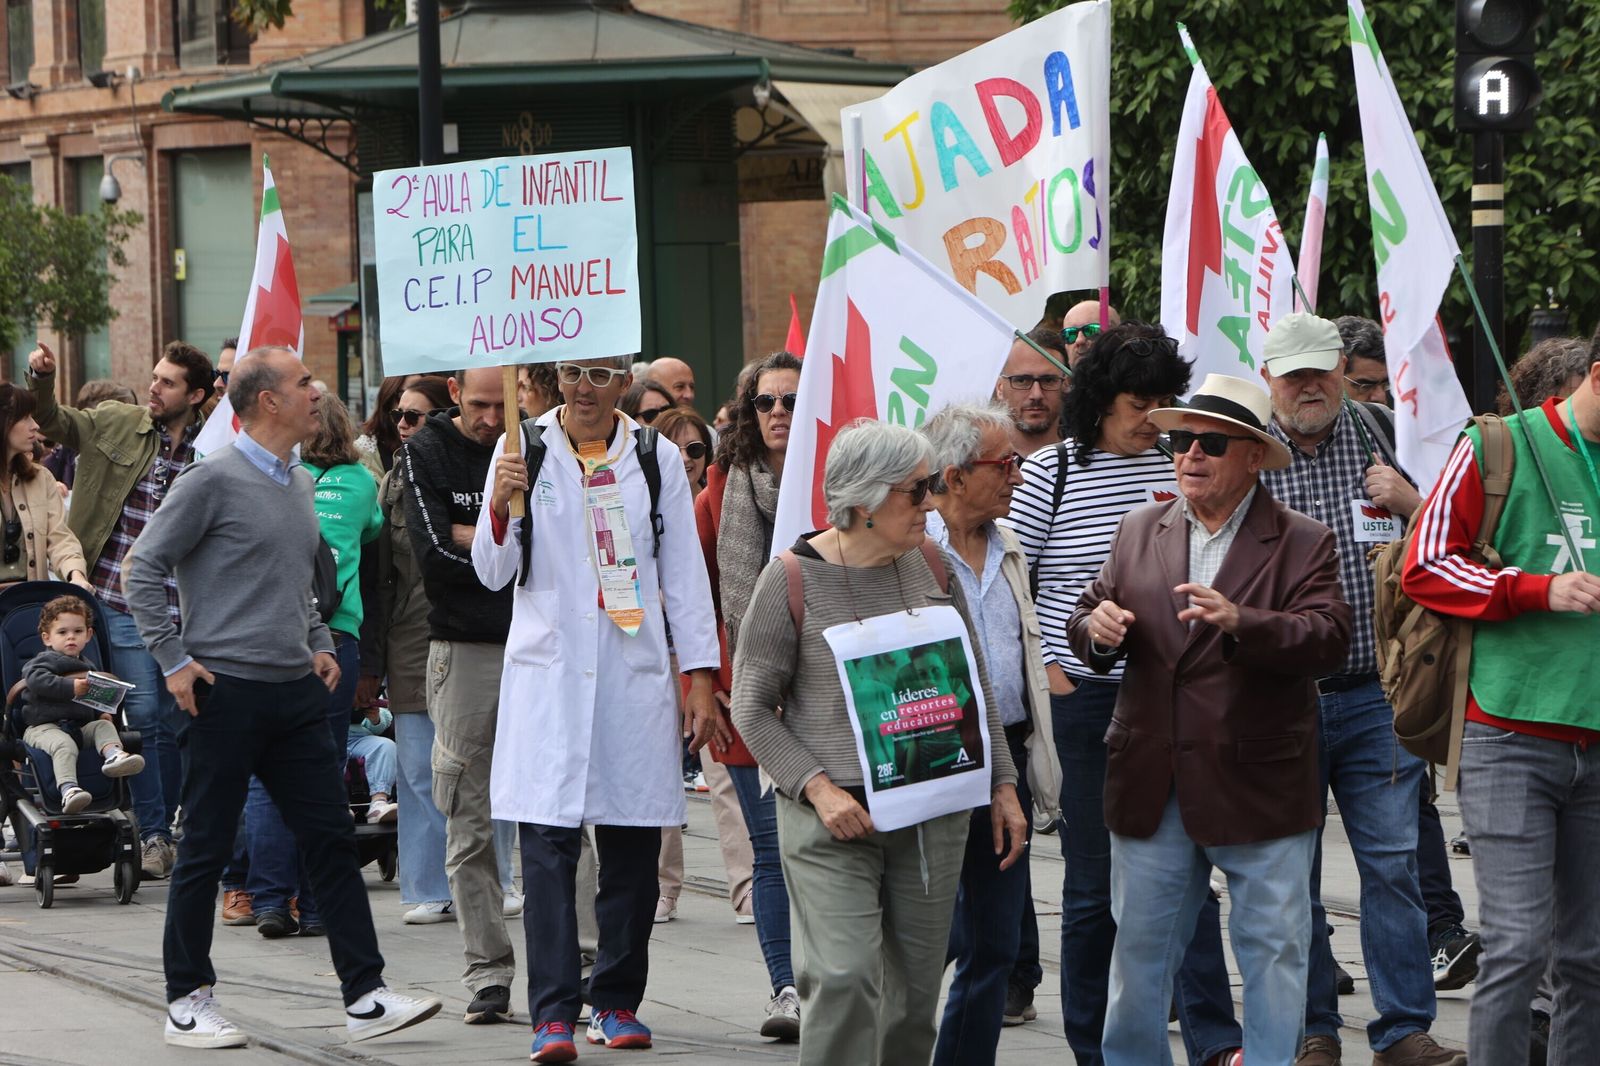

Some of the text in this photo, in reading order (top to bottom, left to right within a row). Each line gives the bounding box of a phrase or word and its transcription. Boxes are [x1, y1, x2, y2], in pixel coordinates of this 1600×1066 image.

[1478, 69, 1510, 115] A
[423, 171, 472, 217] AULA
[480, 165, 511, 209] DE
[522, 159, 624, 206] INFANTIL
[412, 214, 568, 266] PARA EL
[404, 258, 626, 312] C.E.I.P MANUEL
[469, 307, 583, 355] ALONSO
[1362, 521, 1394, 532] USTEA
[880, 697, 954, 721] en recortes
[891, 686, 939, 705] Líderes
[886, 711, 956, 732] educativos
[877, 763, 894, 778] 28F
